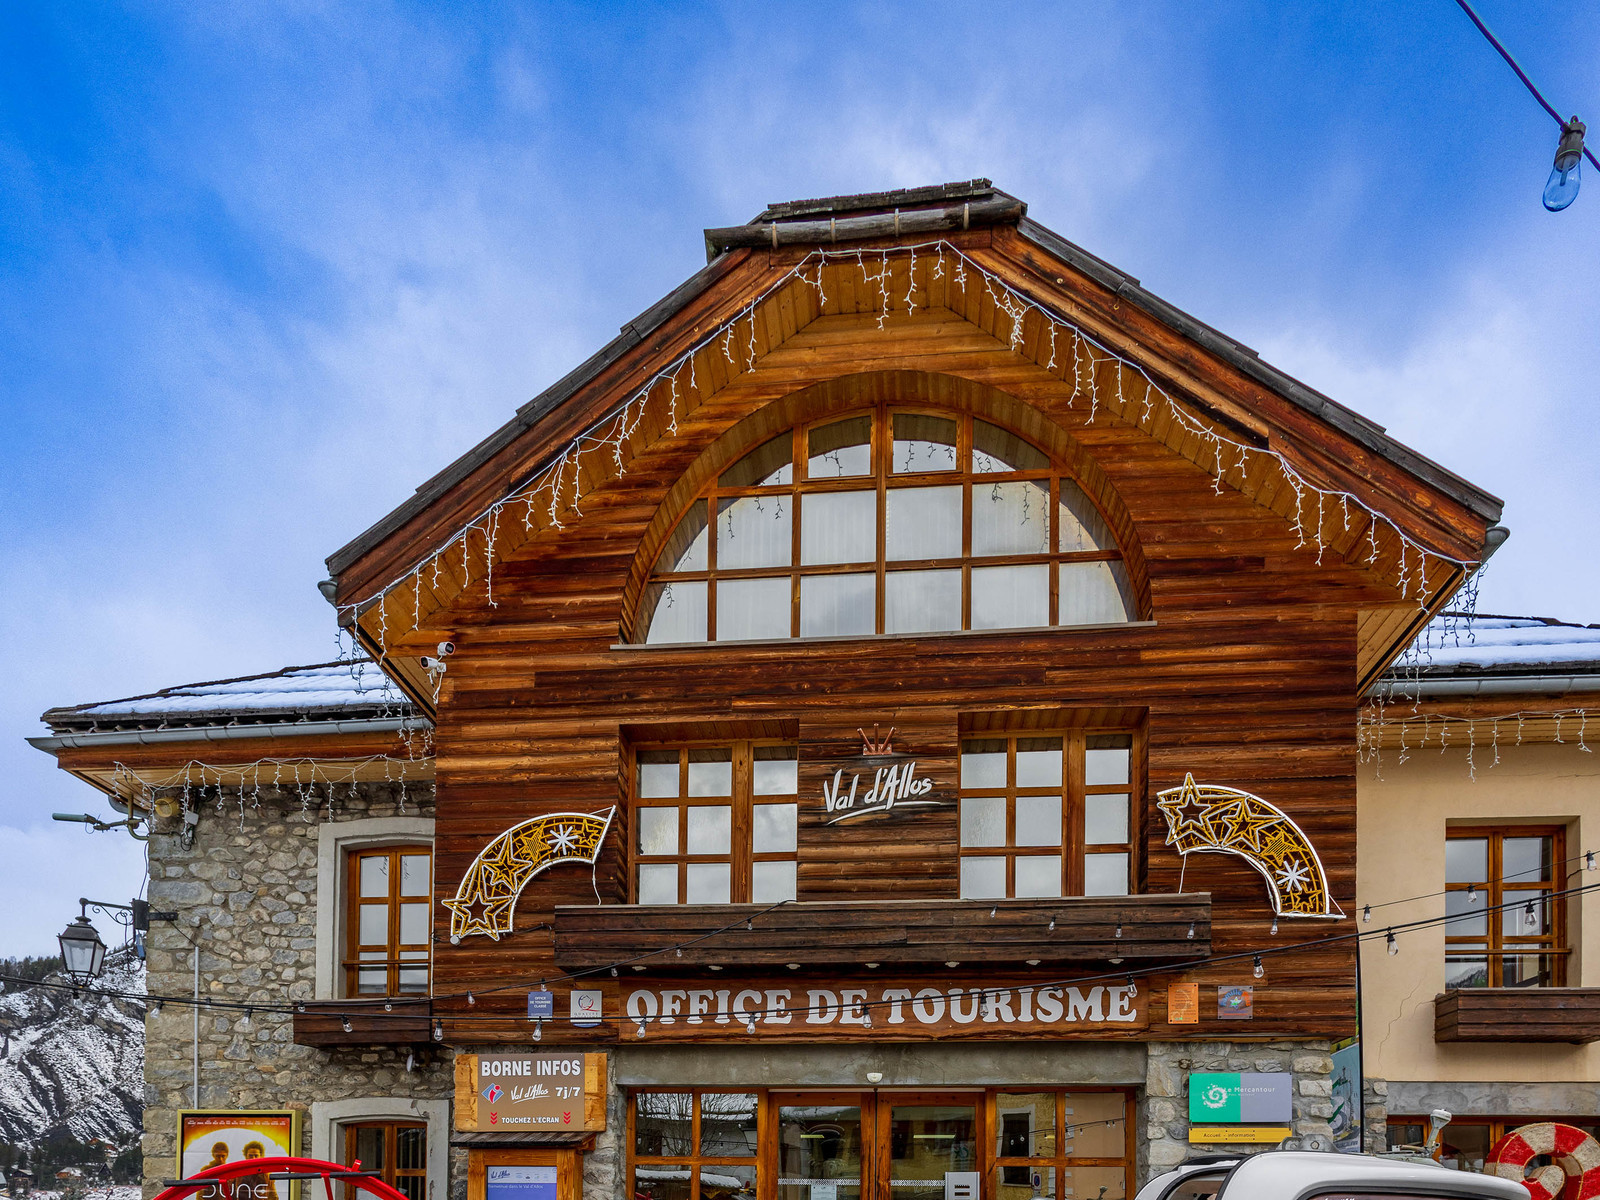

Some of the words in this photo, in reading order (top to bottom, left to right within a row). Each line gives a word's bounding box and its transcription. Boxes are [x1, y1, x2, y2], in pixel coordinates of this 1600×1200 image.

[823, 769, 860, 813] Val
[864, 761, 933, 810] d'Allos
[626, 989, 793, 1025] OFFICE
[805, 989, 870, 1025] DE
[881, 986, 1138, 1024] TOURISME
[481, 1060, 532, 1077] BORNE
[536, 1060, 581, 1076] INFOS
[510, 1085, 524, 1100] Val
[524, 1084, 549, 1100] d'Allos
[555, 1086, 580, 1099] 7j/7
[202, 1183, 268, 1199] DUNE
